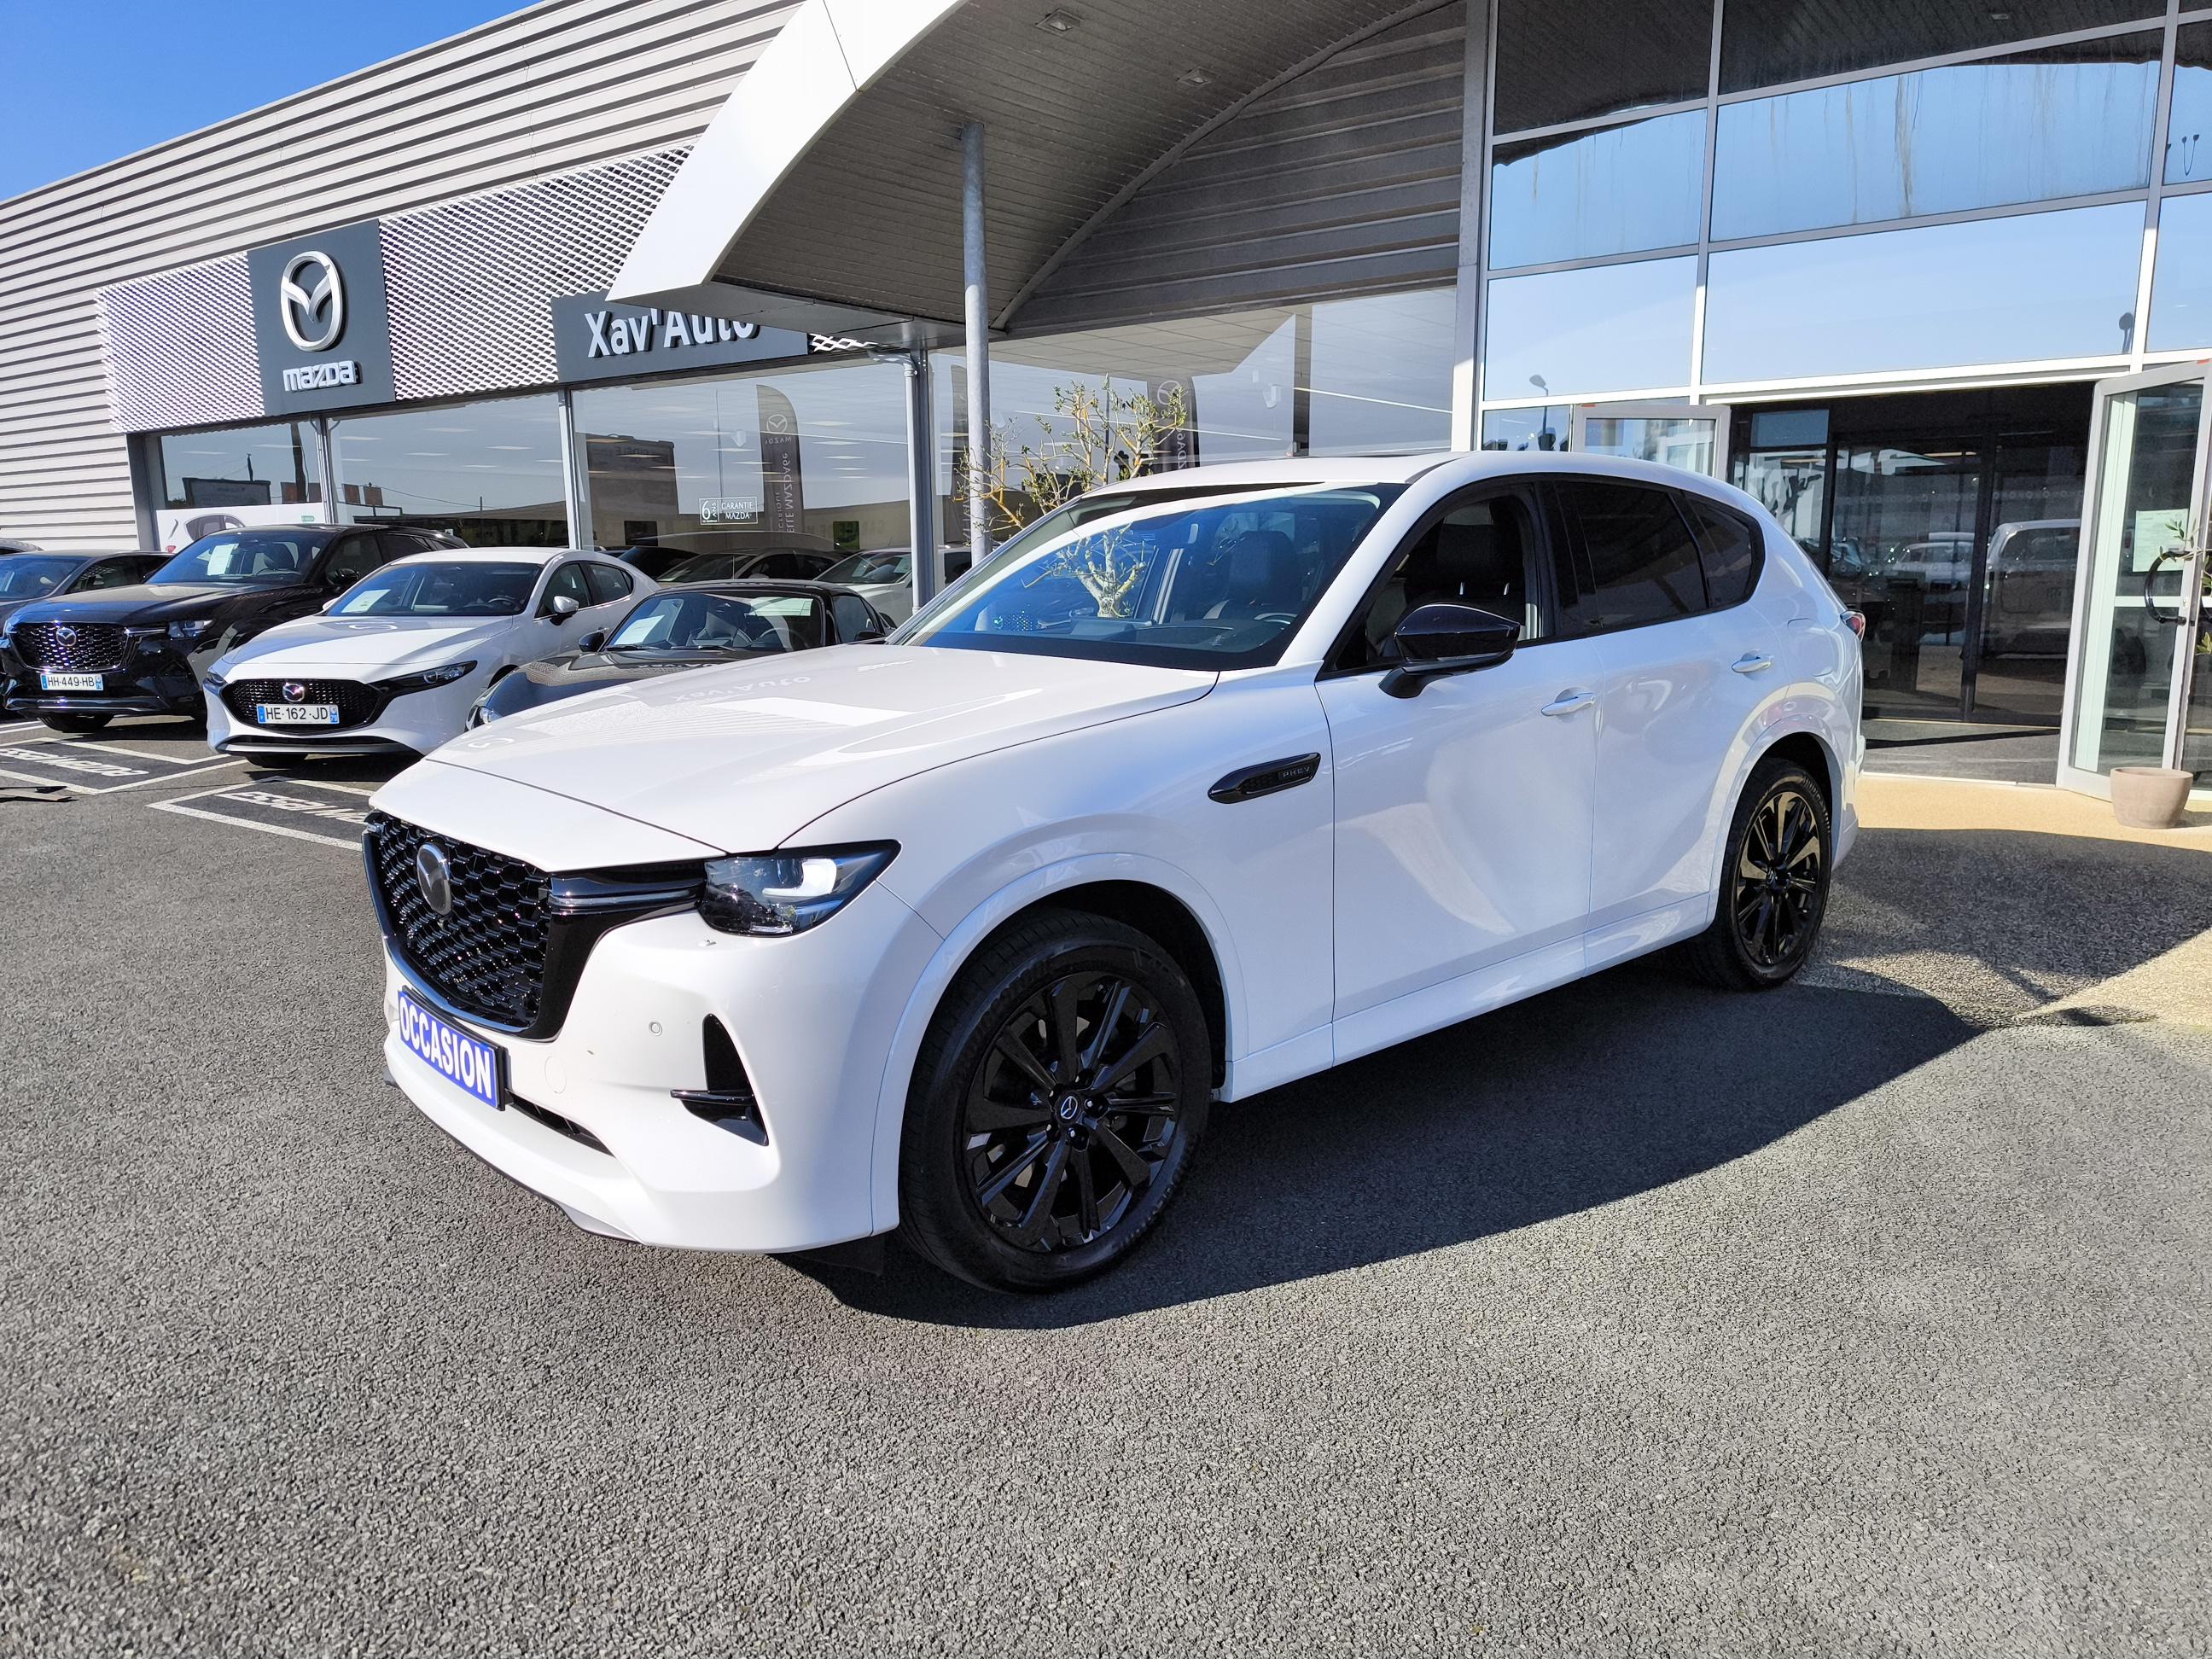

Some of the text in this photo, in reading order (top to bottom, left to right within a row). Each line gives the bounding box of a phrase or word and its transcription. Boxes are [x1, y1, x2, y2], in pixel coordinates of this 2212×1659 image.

[701, 500, 711, 520] 6
[721, 501, 754, 510] GARANTIE
[725, 511, 750, 520] MAZDA
[399, 996, 492, 1100] OCCASION
